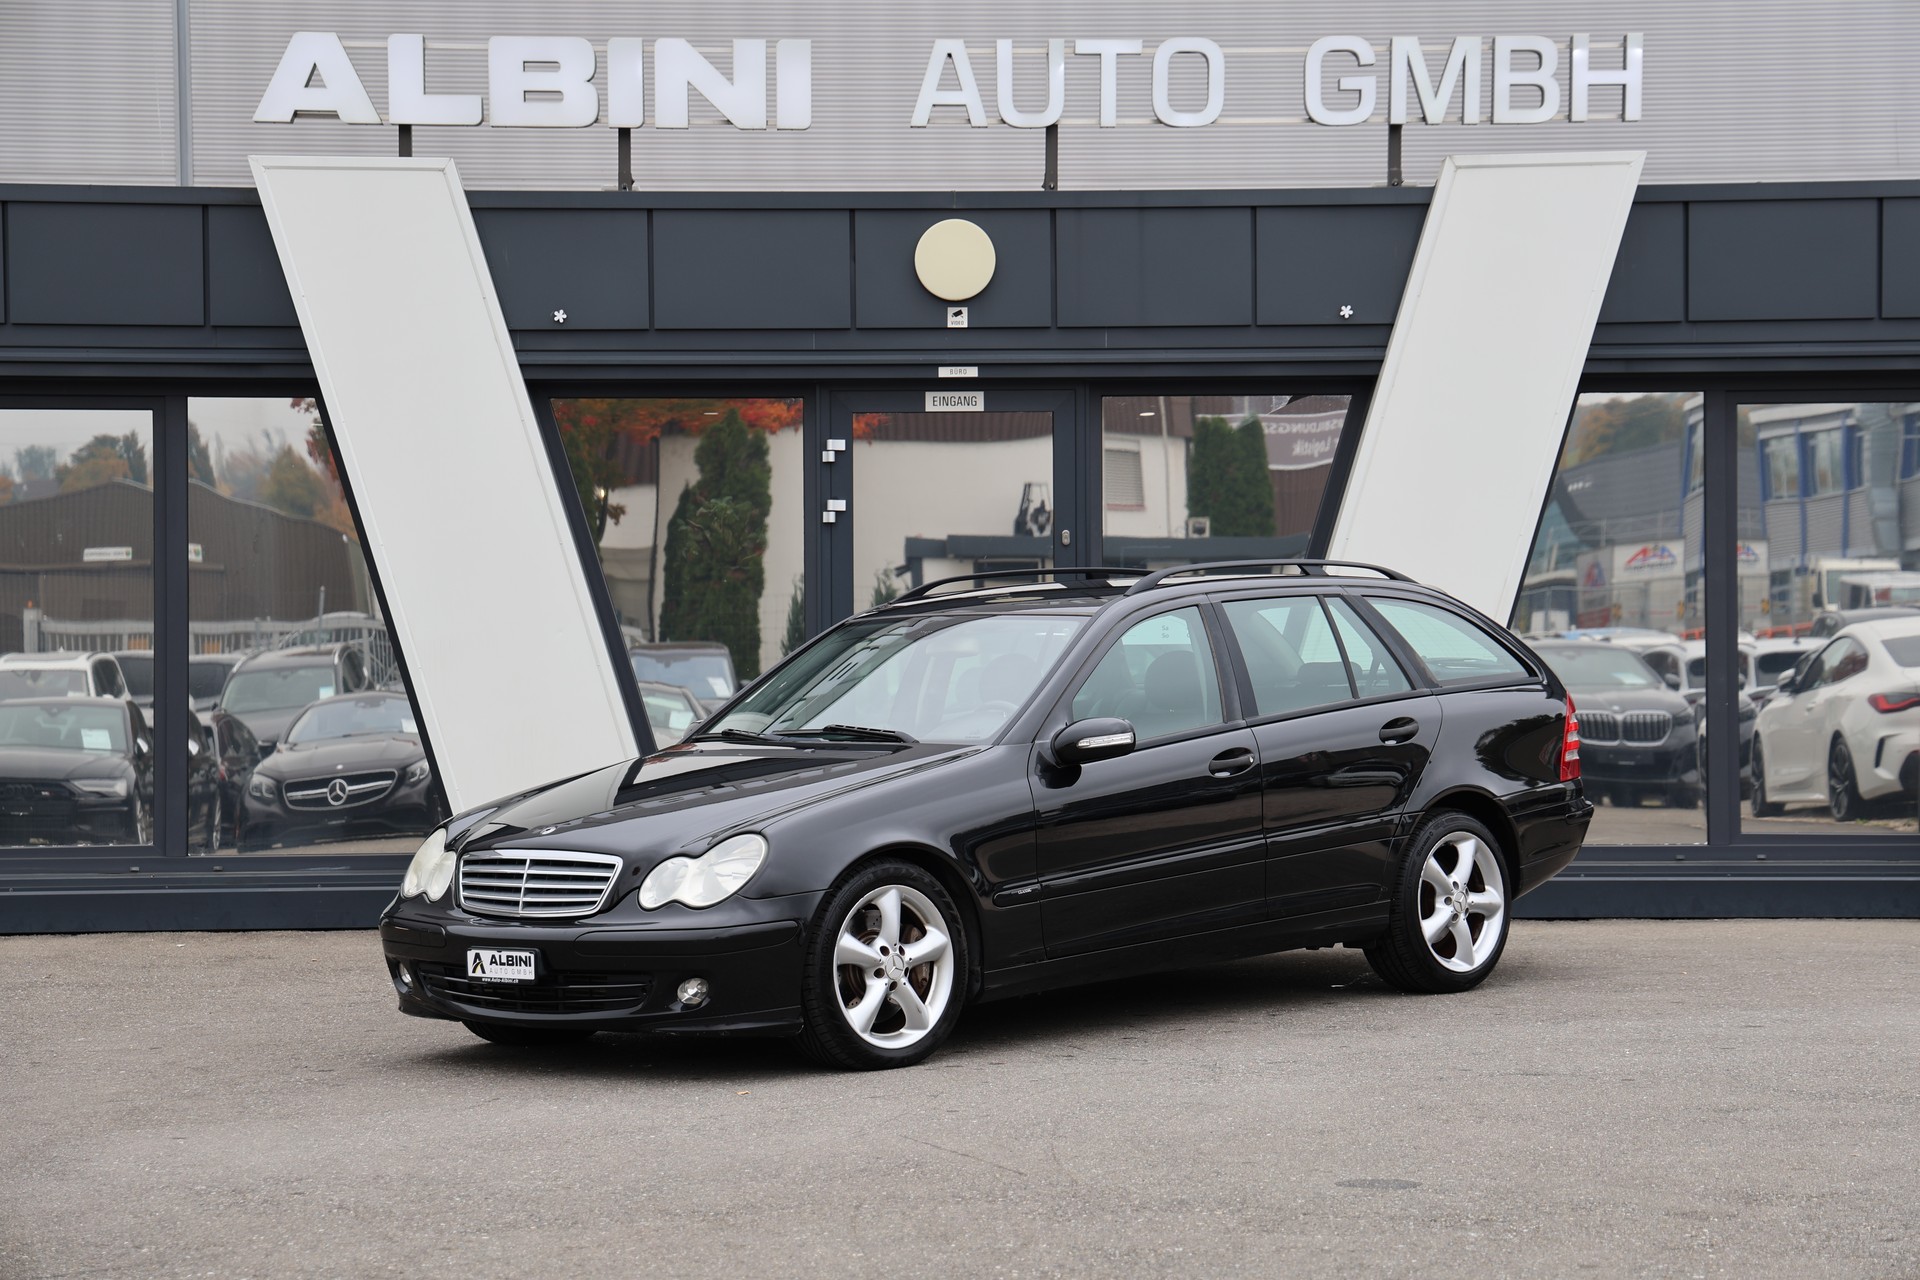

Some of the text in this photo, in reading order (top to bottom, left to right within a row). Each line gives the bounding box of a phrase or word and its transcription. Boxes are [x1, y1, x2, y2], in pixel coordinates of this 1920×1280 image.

[253, 31, 1645, 130] ALBINI AUTO GMBH
[949, 367, 968, 375] BÜRO
[932, 395, 978, 407] EINGANG
[489, 954, 532, 967] ALBINI
[489, 967, 533, 976] AUTO GMBH
